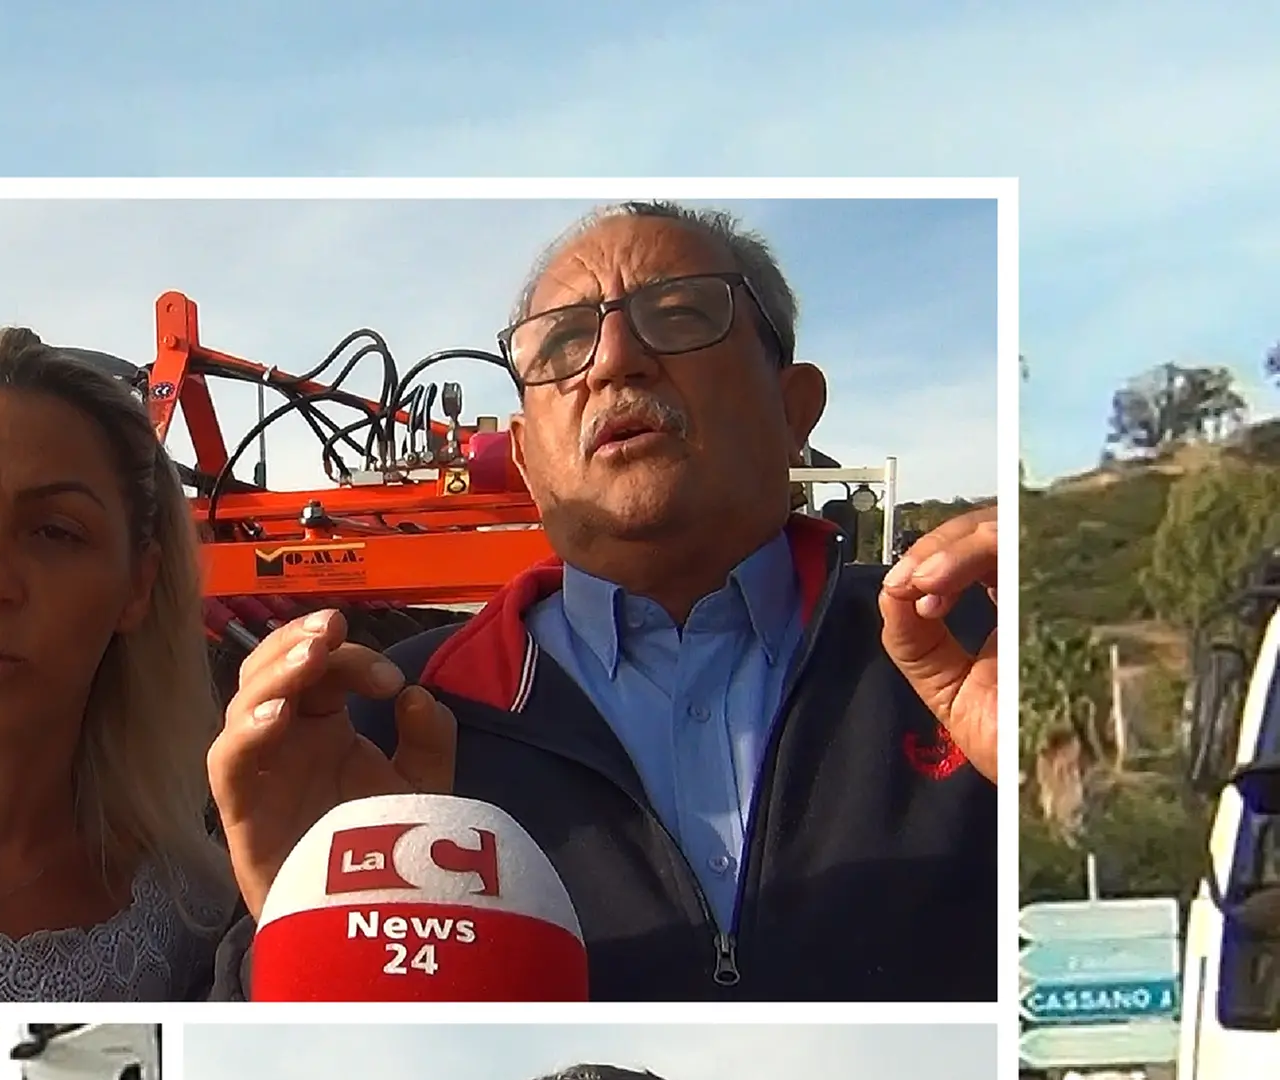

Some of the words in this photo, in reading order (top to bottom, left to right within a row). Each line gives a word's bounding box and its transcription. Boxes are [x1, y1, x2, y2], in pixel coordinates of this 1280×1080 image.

[341, 848, 385, 874] La
[347, 910, 477, 943] News
[382, 943, 438, 975] 24
[1027, 988, 1152, 1012] CASSANO
